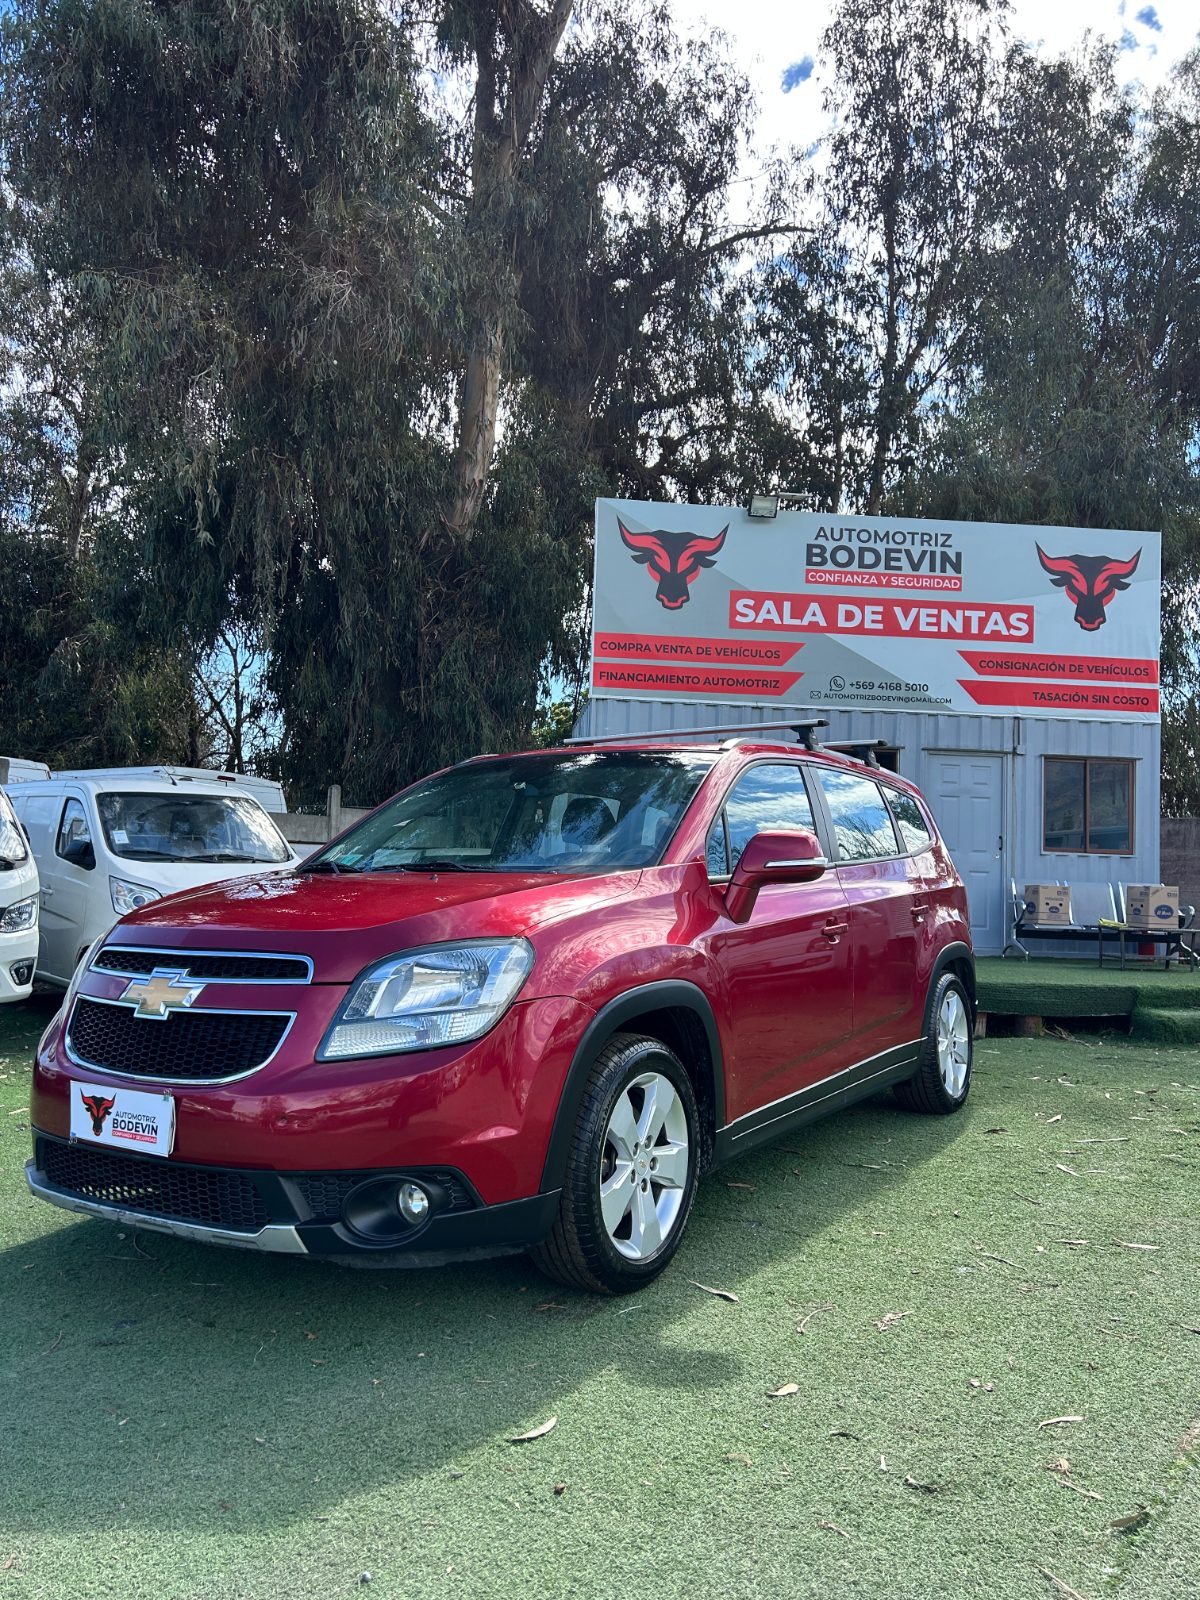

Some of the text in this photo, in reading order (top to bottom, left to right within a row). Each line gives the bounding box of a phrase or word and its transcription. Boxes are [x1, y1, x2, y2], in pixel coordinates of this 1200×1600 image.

[814, 526, 953, 548] AUTOMOTRIZ
[806, 543, 962, 574] BODEVIN
[808, 572, 960, 589] CONFIANZA Y SEGURIDAD
[735, 598, 1029, 636] SALA DE VENTAS
[600, 641, 781, 659] COMPRA VENTA DE VEHÍCULOS
[979, 660, 1149, 676] CONSIGNACIÓN DE VEHÍCULOS
[599, 671, 780, 689] FINANCIAMIENTO AUTOMOTRIZ
[849, 681, 929, 692] +569 4168 5010
[823, 692, 952, 704] AUTOMOTRIZBODEVIN@GMAIL.COM
[1033, 691, 1149, 706] TASACIÓN SIN COSTO
[115, 1110, 156, 1124] AUTOMOTRIZ
[112, 1118, 158, 1136] BODEVIN
